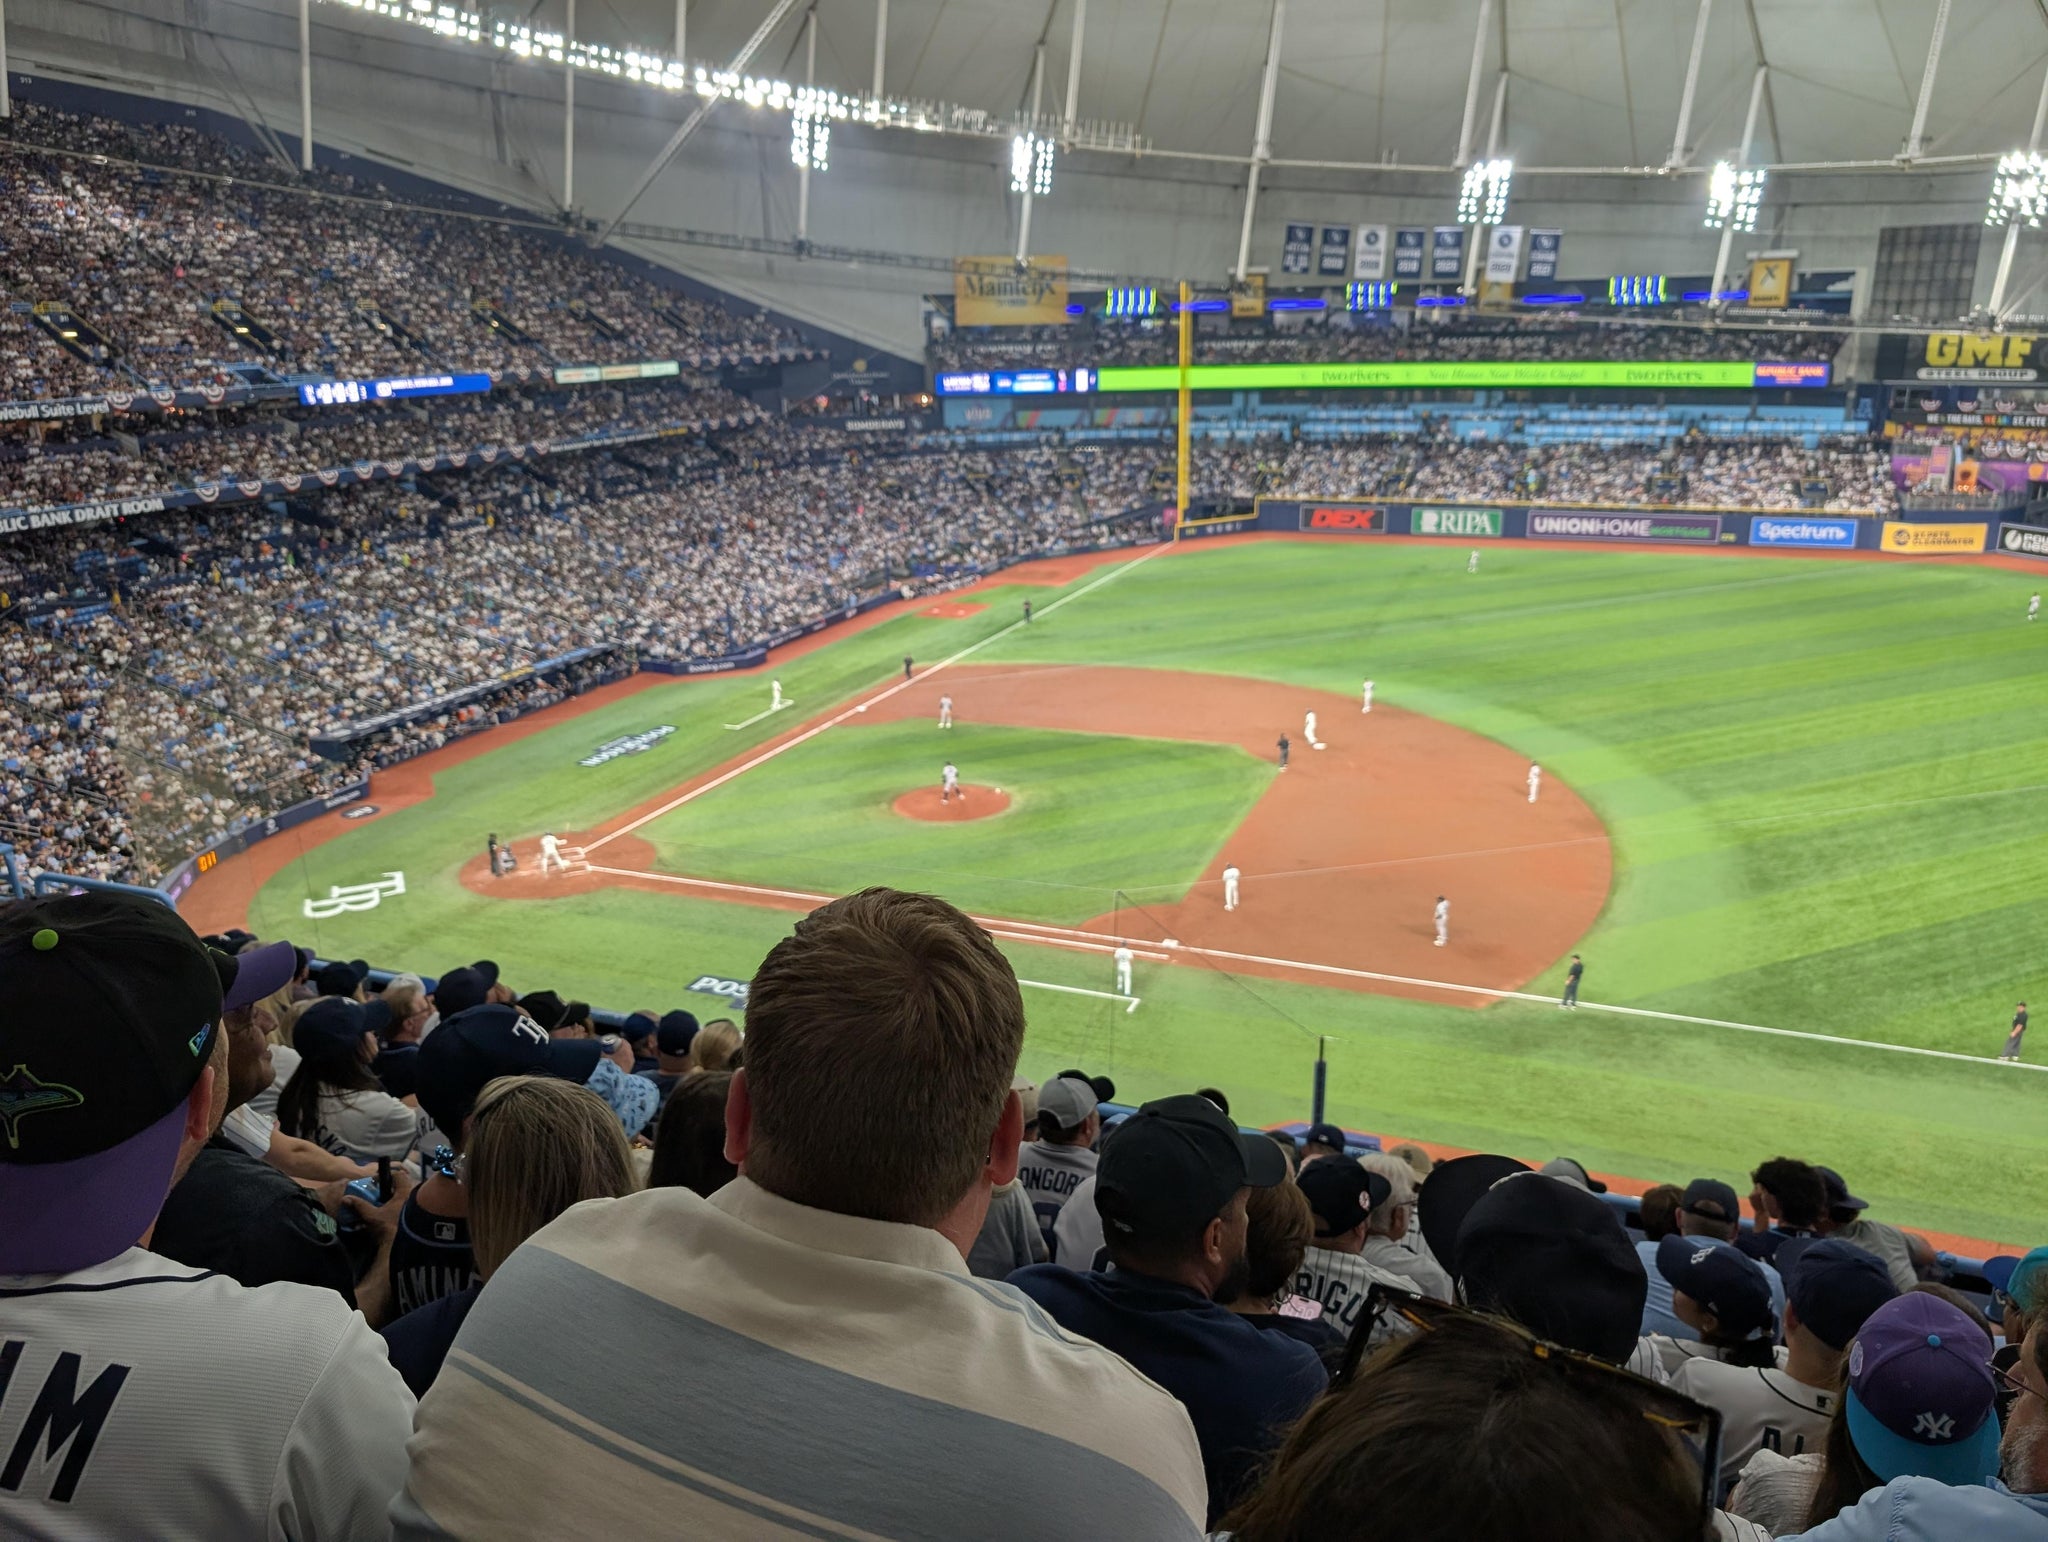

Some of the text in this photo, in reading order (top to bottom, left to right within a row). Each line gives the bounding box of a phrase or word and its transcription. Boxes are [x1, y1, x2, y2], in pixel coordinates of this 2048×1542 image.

[1925, 333, 2038, 367] GMF
[1926, 368, 2029, 378] STEEL GROUP
[41, 402, 74, 418] Suite
[76, 400, 110, 415] Level
[30, 512, 73, 529] BANK
[74, 503, 120, 523] DRAFT
[122, 498, 165, 516] ROOM
[1310, 507, 1375, 530] DEX
[1440, 510, 1493, 535] RIPA
[1758, 522, 1838, 541] Spectrum
[1912, 1411, 1956, 1439] NY
